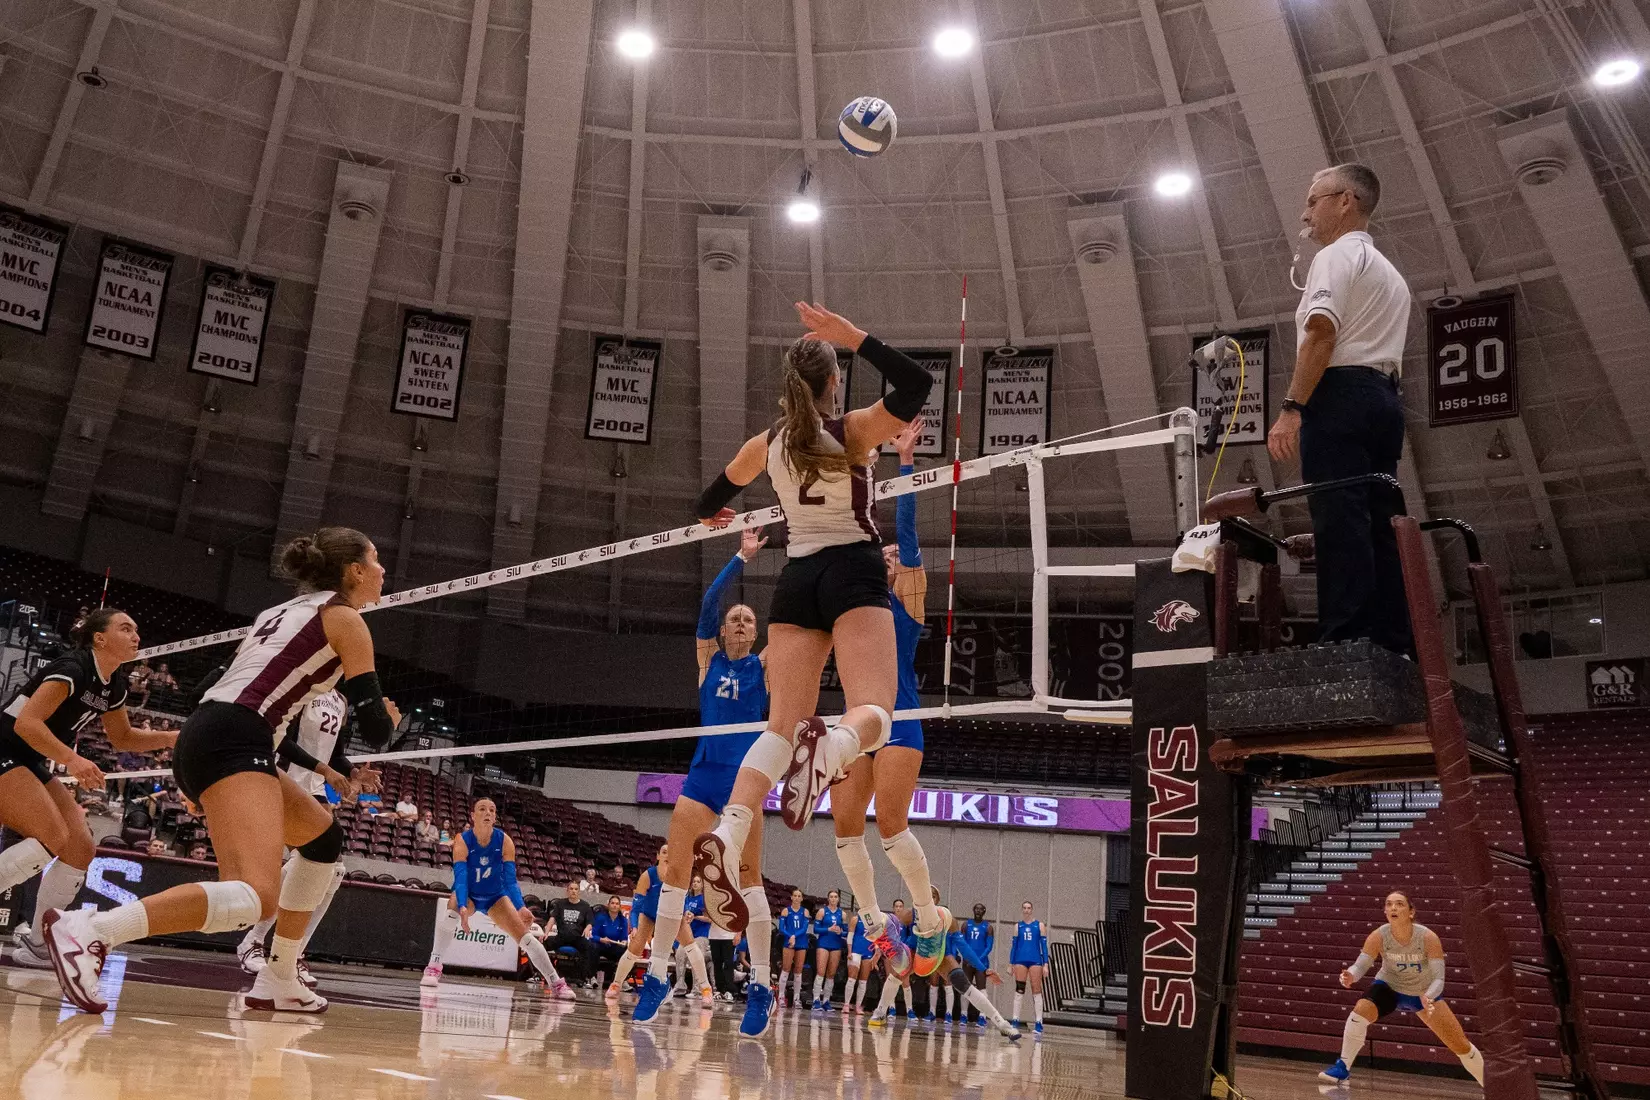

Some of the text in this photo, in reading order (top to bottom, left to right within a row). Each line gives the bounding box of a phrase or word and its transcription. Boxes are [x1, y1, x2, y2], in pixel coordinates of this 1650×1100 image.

[0, 236, 55, 258] ASKETBALL
[12, 232, 41, 247] MEN'S
[1, 251, 40, 276] MVC
[120, 264, 148, 276] MEN'S
[0, 270, 48, 291] AMPIONS
[103, 266, 162, 286] BASKETBALL
[105, 281, 152, 306] NCAA
[222, 291, 250, 302] MEN'S
[0, 298, 41, 321] 004
[98, 298, 156, 318] TOURNAMENT
[207, 294, 263, 312] BASKETBALL
[214, 309, 250, 331] MVC
[1443, 316, 1498, 334] VAUGHN
[92, 325, 150, 348] 2003
[201, 323, 258, 344] CHAMPIONS
[422, 332, 448, 341] MEN'S
[407, 336, 460, 350] BASKETBALL
[198, 352, 252, 373] 2003
[409, 350, 453, 370] NCAA
[598, 362, 652, 374] BASKETBALL
[1439, 337, 1505, 386] 20
[413, 367, 447, 380] SWEET
[987, 376, 1045, 384] BASKETBALL
[407, 377, 450, 391] SIXTEEN
[606, 376, 640, 393] MVC
[399, 392, 452, 410] 2002
[595, 392, 648, 405] CHAMPIONS
[992, 390, 1039, 405] NCAA
[1438, 392, 1508, 411] 1958-1962
[987, 407, 1044, 416] TOURNAMENT
[593, 418, 645, 434] 2002
[989, 434, 1040, 447] 1994
[389, 593, 401, 603] SIU
[425, 585, 439, 595] SIU
[464, 576, 479, 587] SIU
[506, 567, 521, 578] SIU
[551, 556, 567, 568] SIU
[600, 545, 616, 557] SIU
[652, 533, 670, 545] SIU
[912, 471, 938, 487] SIU
[253, 608, 288, 646] 4
[37, 658, 52, 669] 10
[951, 619, 977, 695] 1977
[1097, 621, 1125, 700] 2002
[715, 675, 739, 700] 21
[1593, 683, 1634, 697] G&R
[1593, 696, 1636, 705] RENTALS
[319, 711, 338, 736] 22
[475, 866, 492, 883] 14
[1141, 723, 1199, 1029] SALUKIS
[793, 920, 800, 929] 11
[970, 931, 980, 940] 17
[1023, 932, 1033, 941] 15
